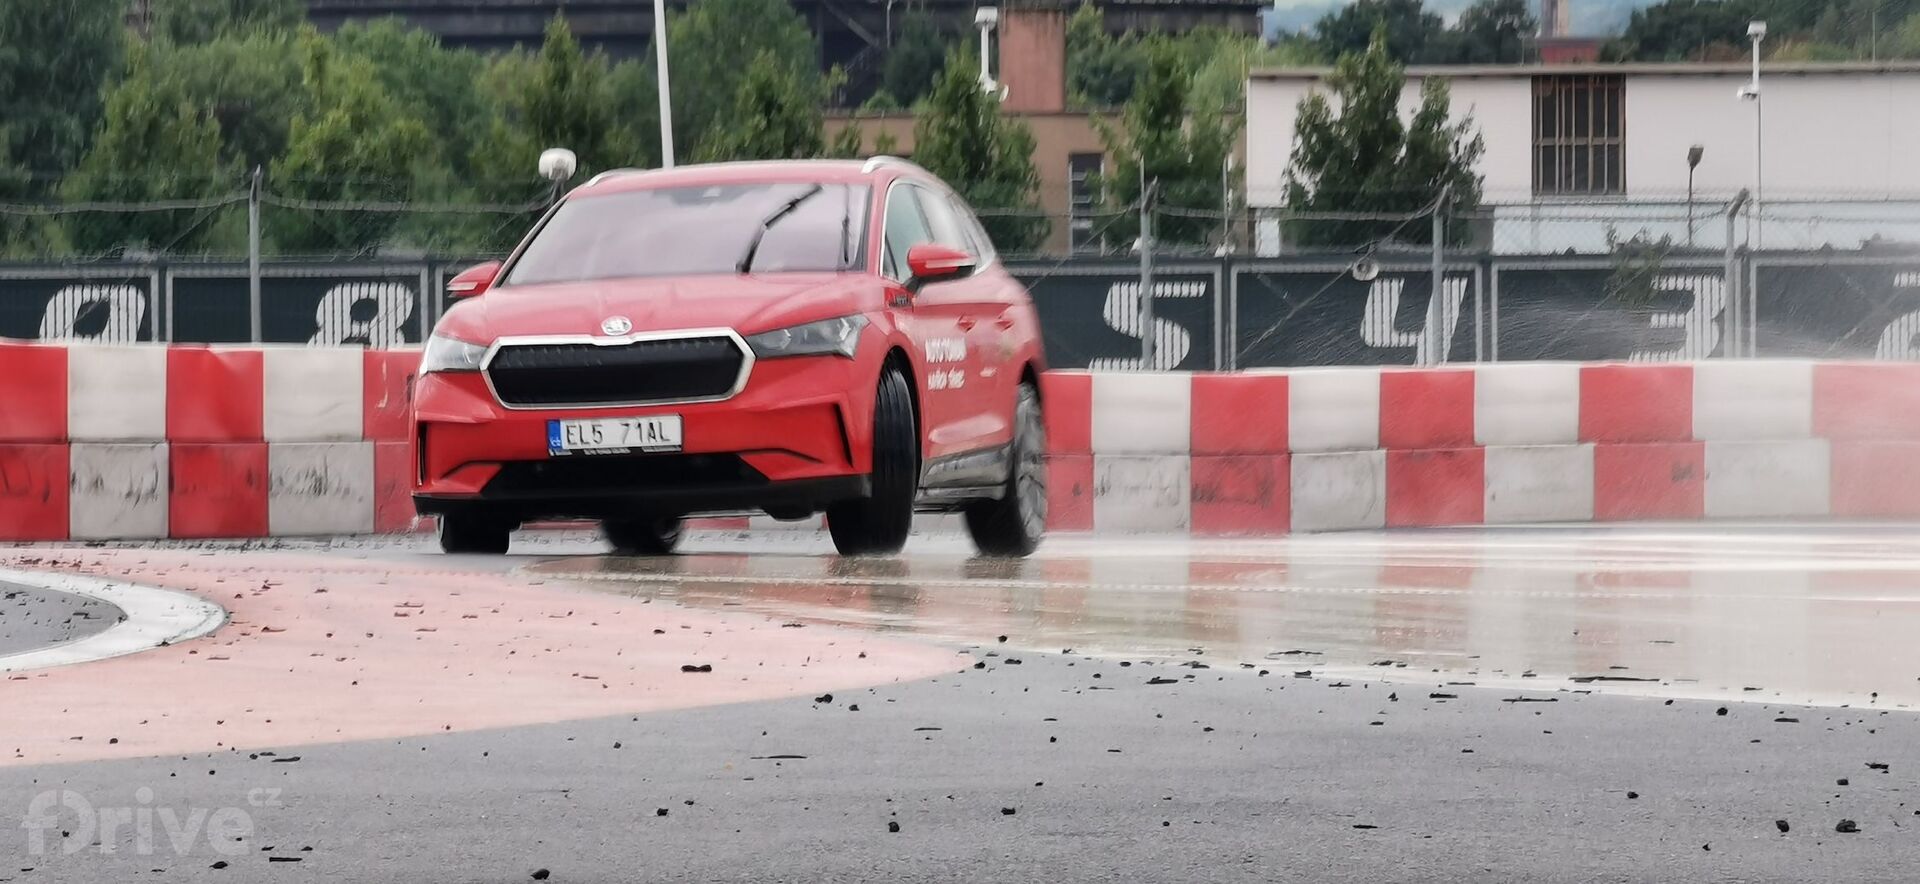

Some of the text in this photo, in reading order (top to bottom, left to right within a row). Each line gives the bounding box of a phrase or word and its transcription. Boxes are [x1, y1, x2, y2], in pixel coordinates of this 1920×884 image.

[306, 282, 414, 349] 8
[1089, 281, 1208, 372] 5
[1360, 277, 1469, 367] 4
[1628, 274, 1728, 362] 3
[565, 420, 671, 446] EL5 71AL
